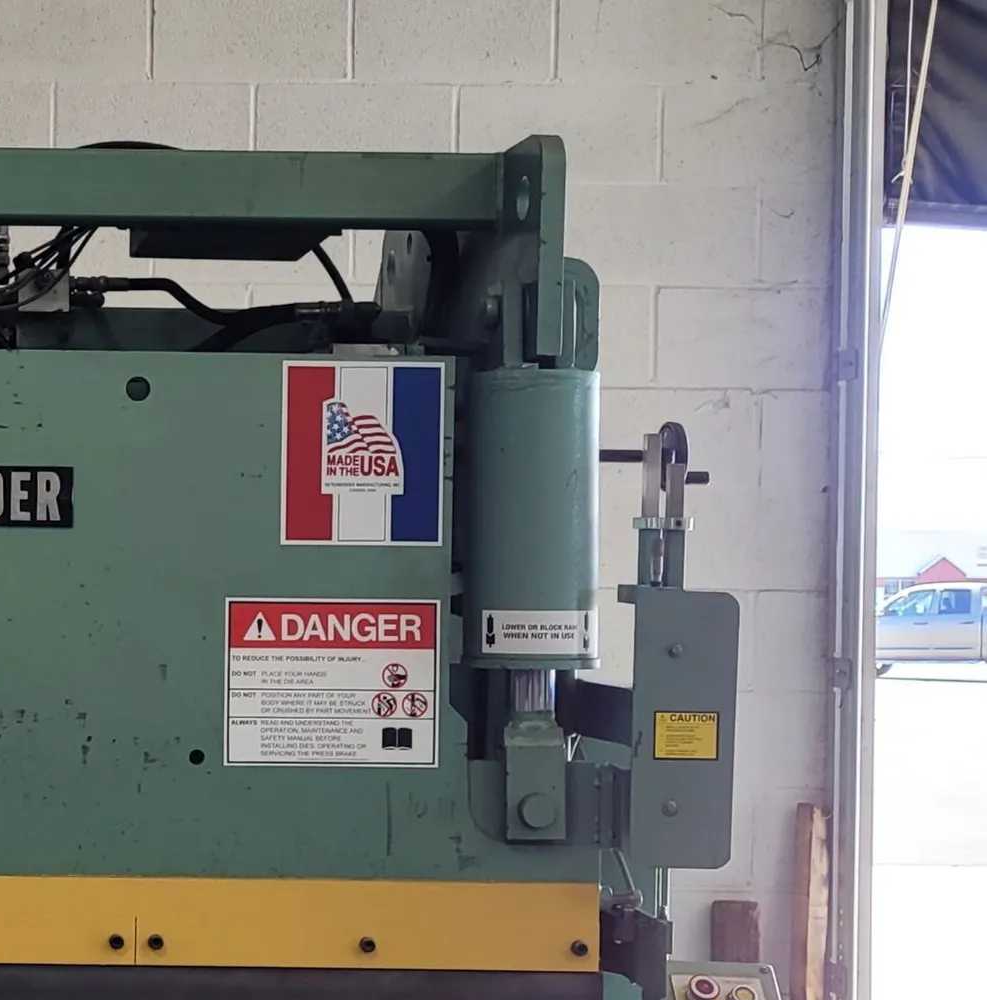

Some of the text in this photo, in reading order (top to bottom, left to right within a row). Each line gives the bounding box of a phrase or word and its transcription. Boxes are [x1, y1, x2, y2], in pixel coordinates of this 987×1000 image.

[327, 455, 359, 466] MADE
[361, 456, 400, 476] USA
[327, 467, 359, 476] IN THE
[281, 613, 422, 642] DANGER
[503, 632, 529, 640] WHEN
[669, 714, 716, 722] CAUTION
